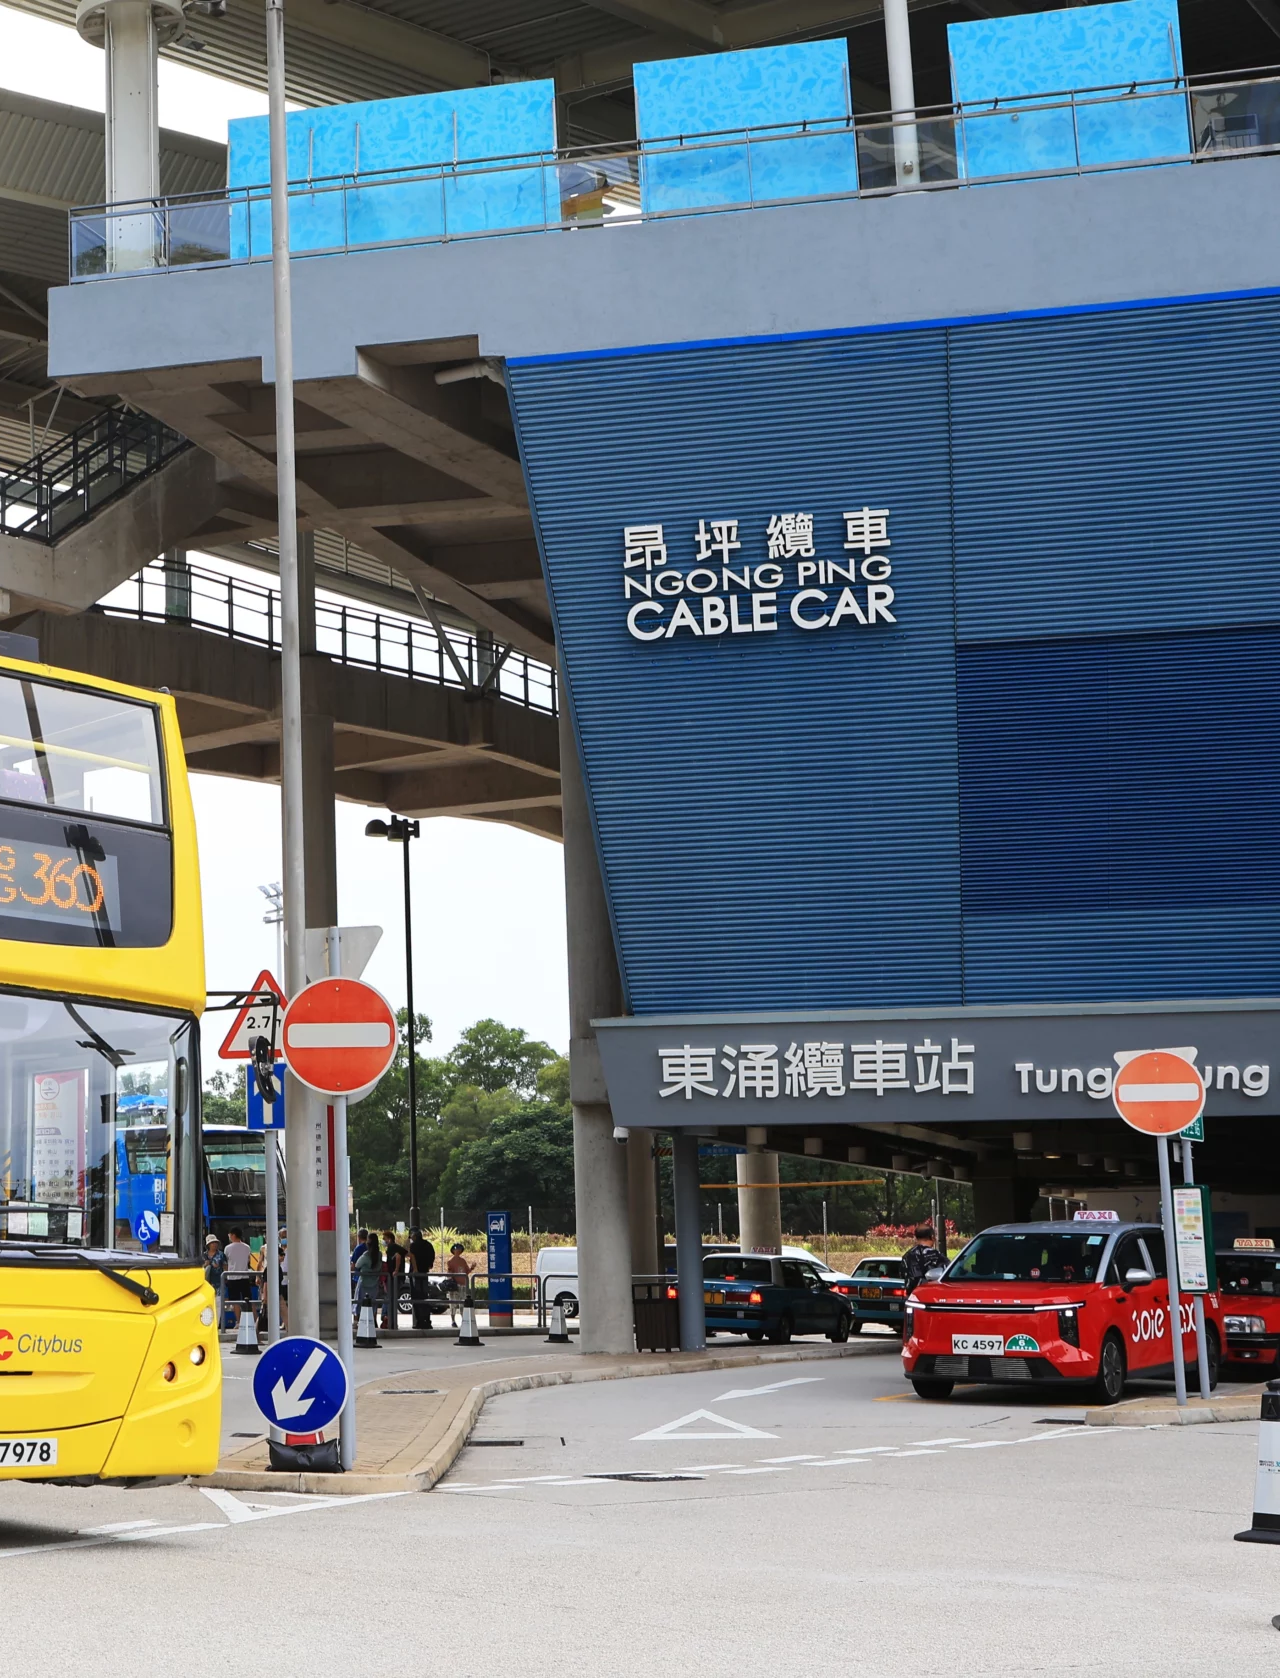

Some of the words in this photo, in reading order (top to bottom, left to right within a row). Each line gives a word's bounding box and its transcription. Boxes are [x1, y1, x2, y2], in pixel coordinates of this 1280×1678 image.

[623, 506, 892, 571] 昂坪纜車
[624, 563, 784, 599] NGONG
[797, 555, 892, 586] PING
[627, 592, 778, 641] CABLE
[789, 584, 897, 630] CAR
[20, 853, 104, 913] 360
[658, 1038, 976, 1100] 東涌纜車站
[1015, 1063, 1113, 1099] Tung
[154, 1179, 167, 1192] BI
[154, 1193, 167, 1205] BU
[1077, 1212, 1113, 1220] TAXI
[17, 1334, 83, 1356] Citybus
[953, 1340, 969, 1350] KC
[972, 1340, 1003, 1351] 4597
[1018, 1339, 1026, 1347] 6
[0, 1441, 52, 1463] 7978
